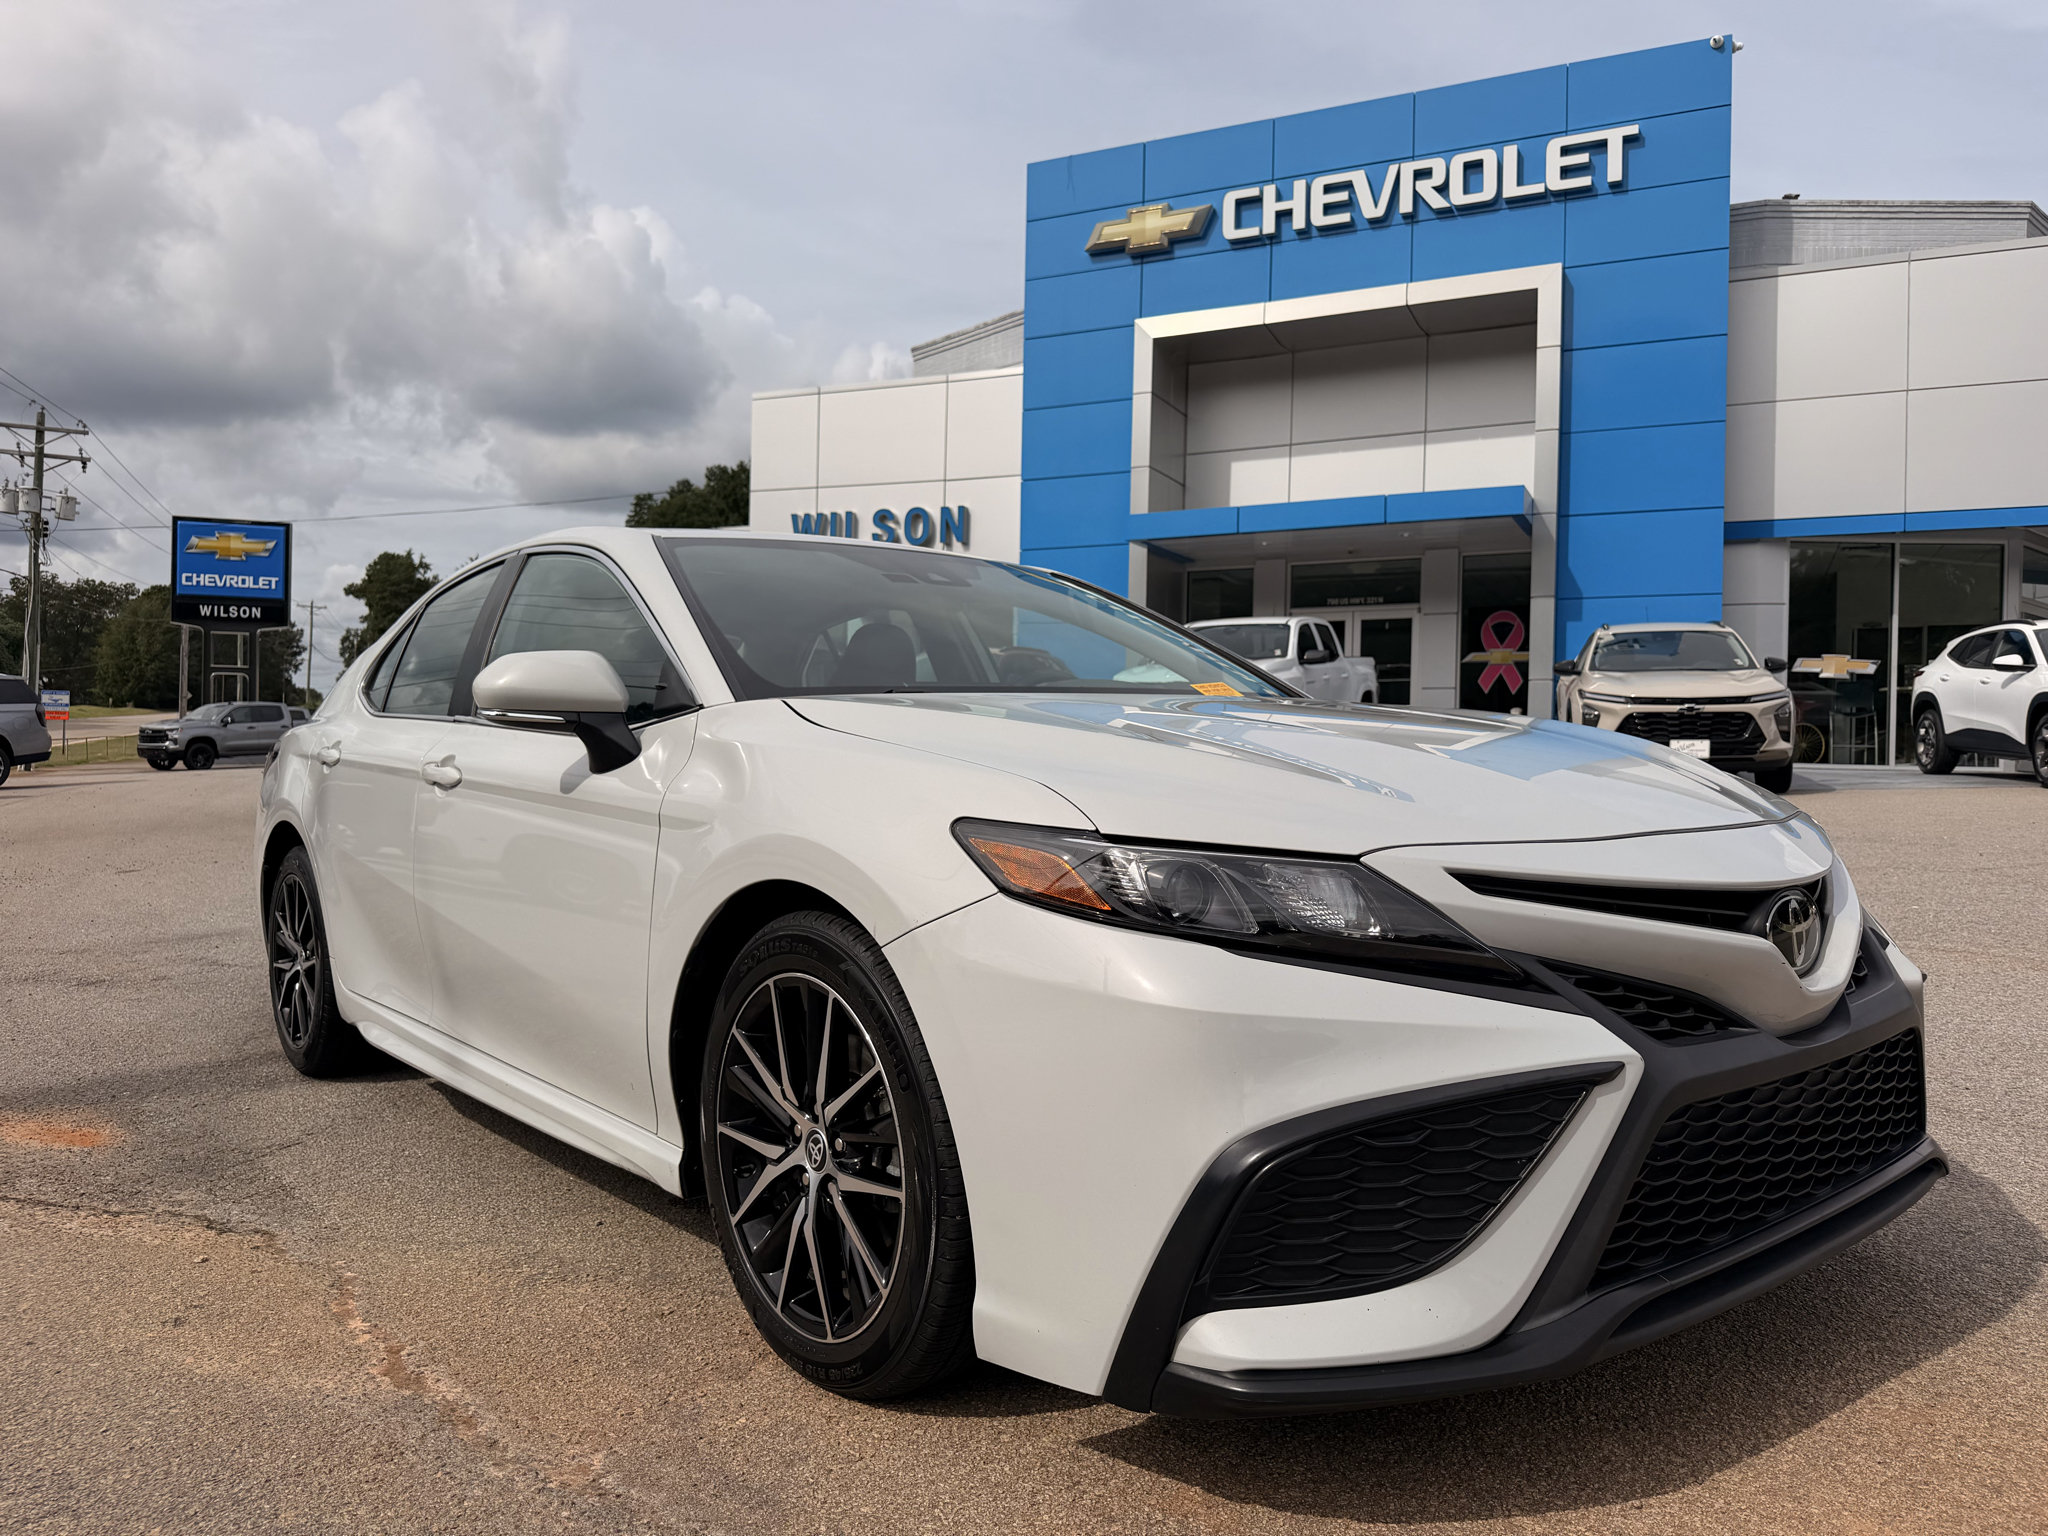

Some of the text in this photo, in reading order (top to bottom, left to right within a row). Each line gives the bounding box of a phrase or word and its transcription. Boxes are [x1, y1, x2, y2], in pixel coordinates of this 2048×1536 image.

[1222, 123, 1640, 243] CHEVROLET
[181, 572, 279, 590] CHEVROLET
[199, 604, 261, 619] WILSON
